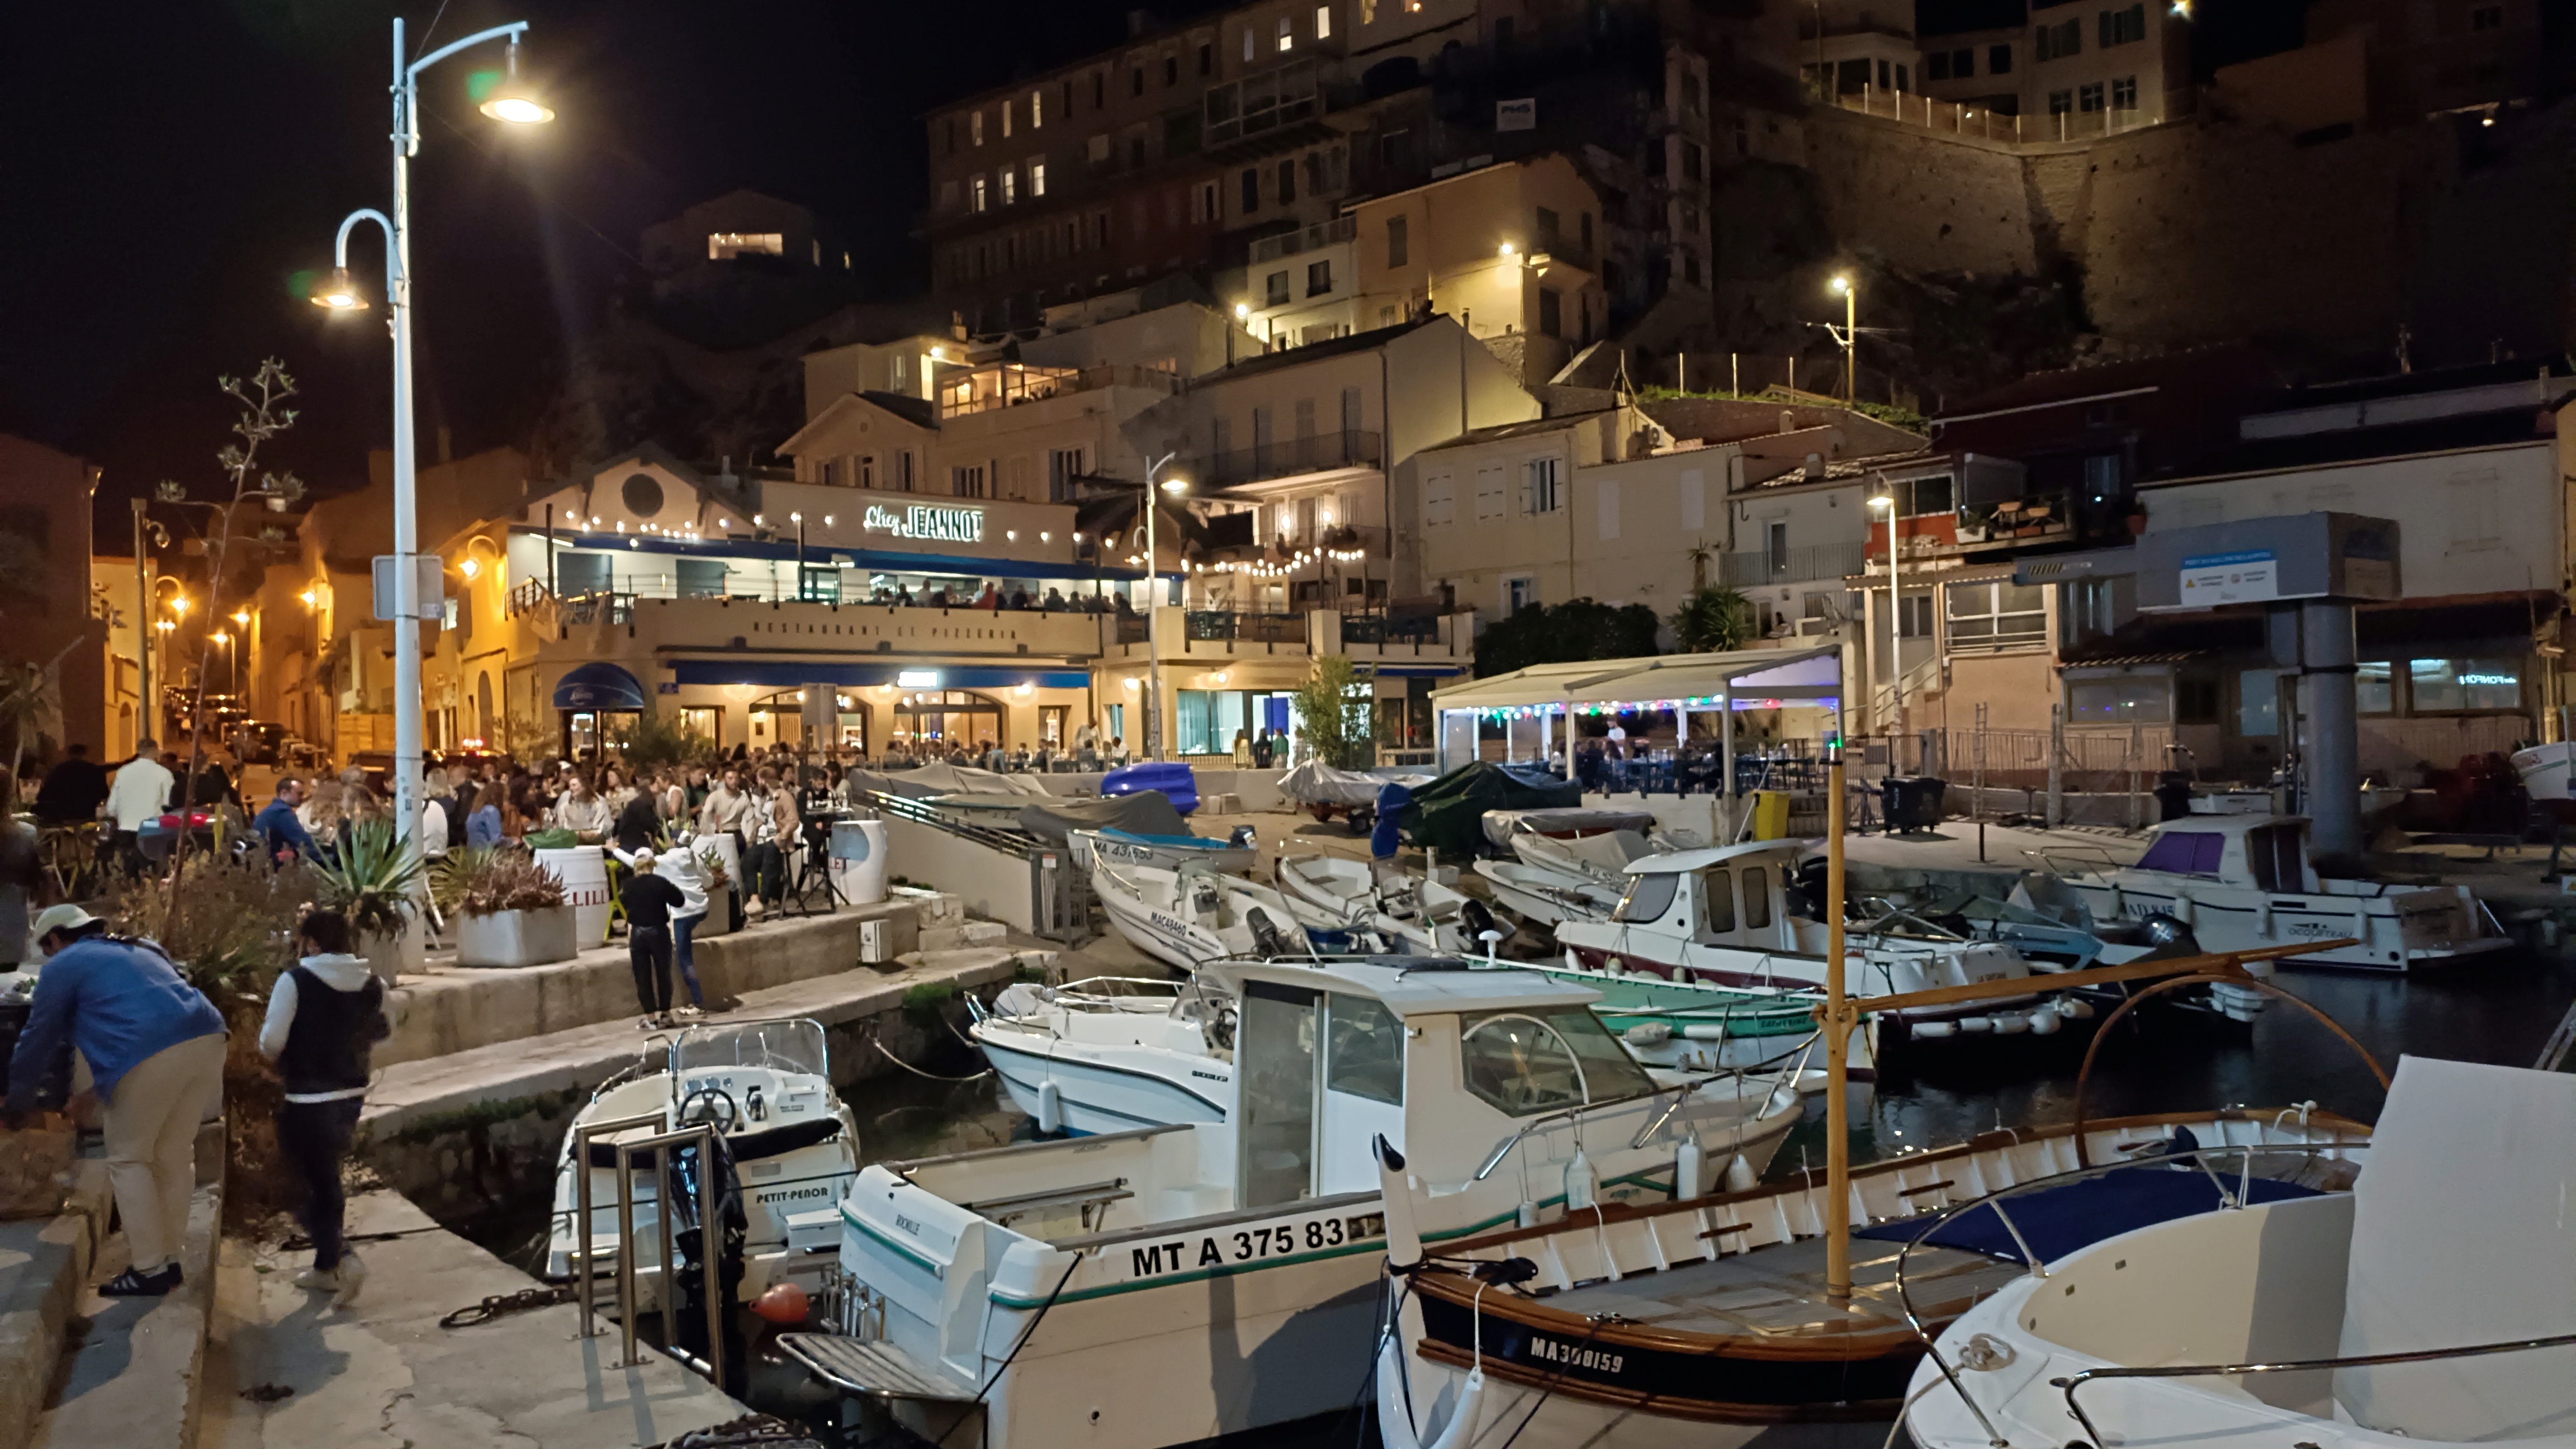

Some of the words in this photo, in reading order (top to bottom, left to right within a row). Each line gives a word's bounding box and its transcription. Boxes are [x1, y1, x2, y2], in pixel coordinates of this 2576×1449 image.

[865, 505, 902, 536] Chez
[904, 505, 983, 542] JEANNOT
[754, 621, 879, 636] RESTAURANT
[932, 627, 1016, 640] PIZZERIA
[1131, 1241, 1185, 1277] MT
[1198, 1237, 1223, 1266] A
[1233, 1225, 1294, 1260] 375
[1305, 1218, 1343, 1248] 83
[1531, 1337, 1623, 1373] MA308159
